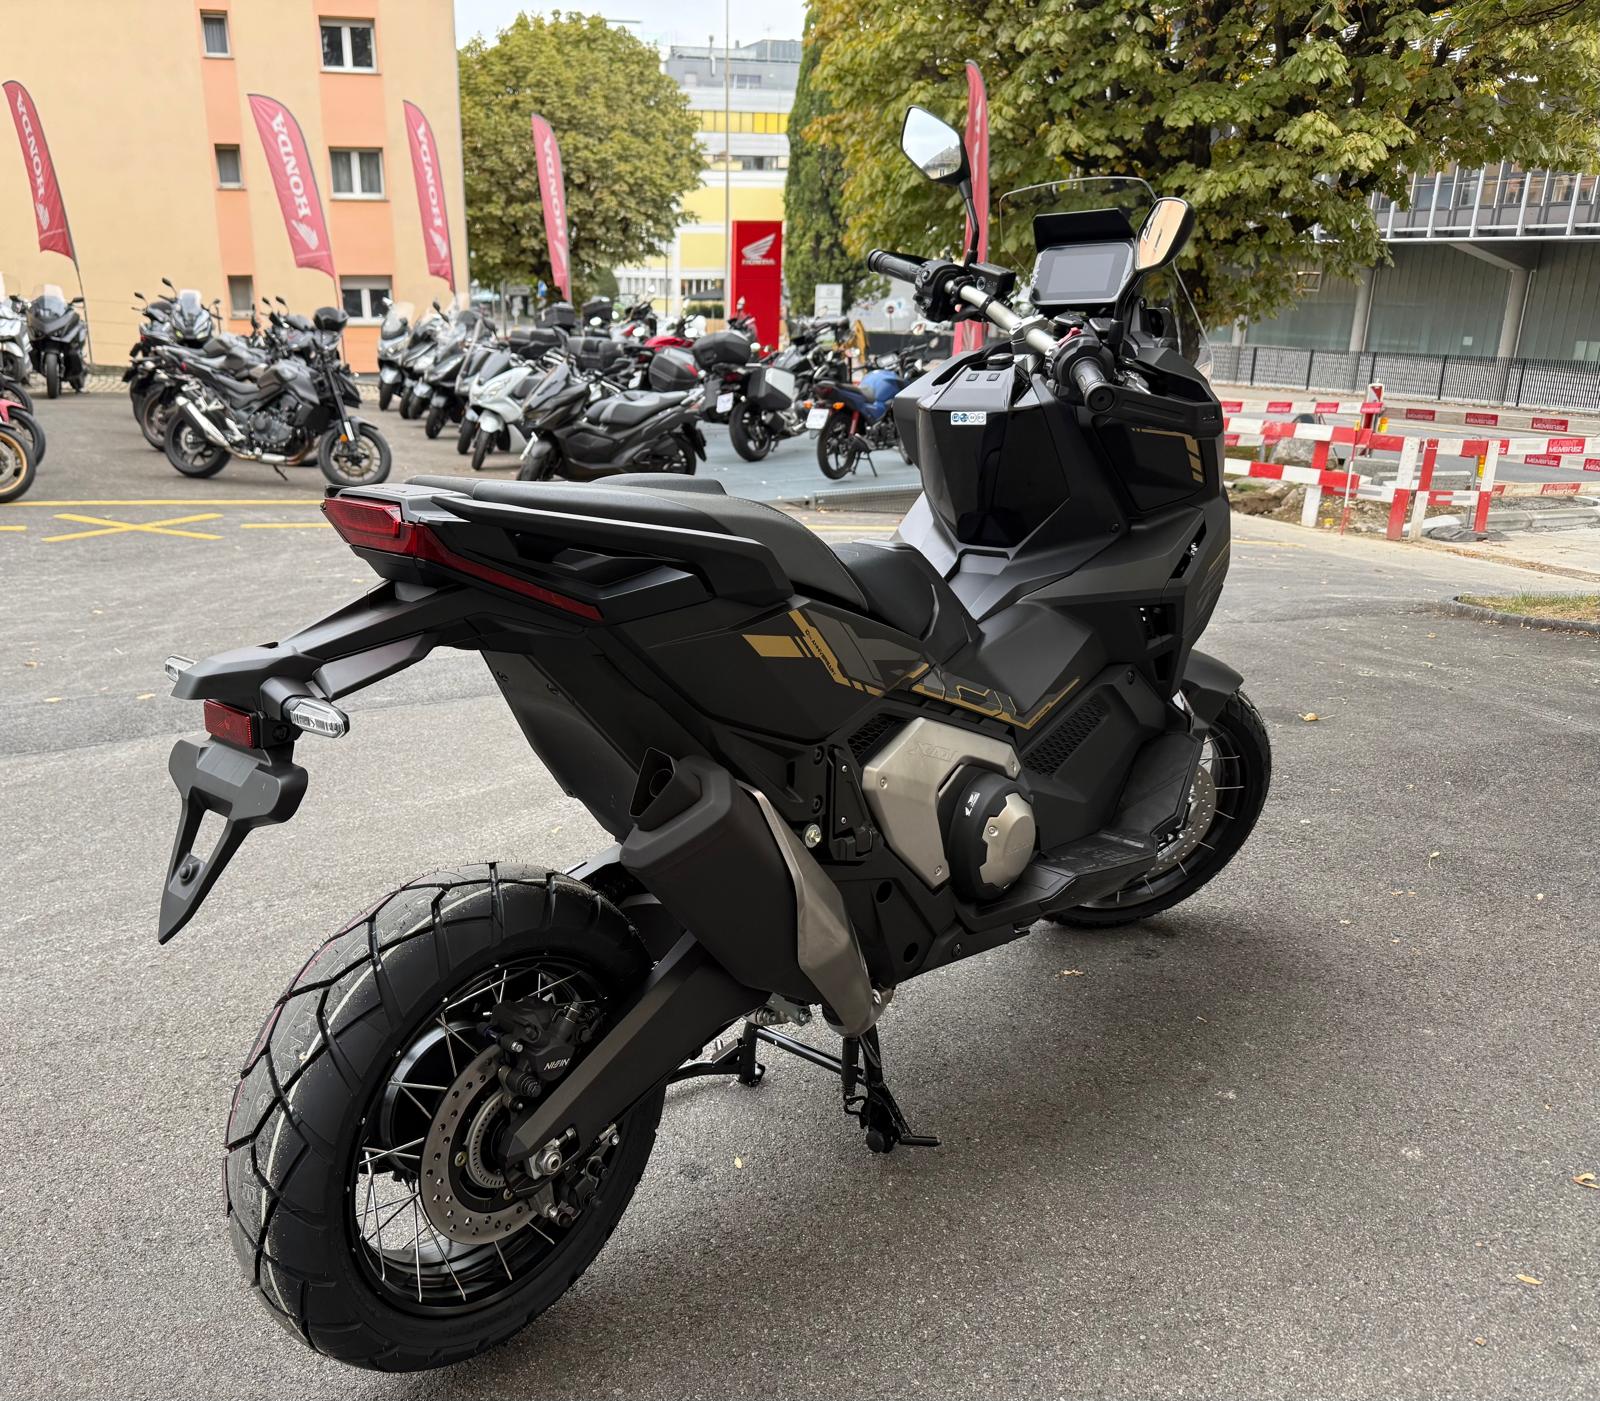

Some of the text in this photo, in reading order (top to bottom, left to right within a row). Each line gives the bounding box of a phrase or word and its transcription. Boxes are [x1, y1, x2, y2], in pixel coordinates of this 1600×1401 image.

[16, 91, 44, 198] HONDA
[271, 111, 312, 218] HONDA
[416, 122, 443, 228] HONDA
[544, 136, 566, 240] HONDA
